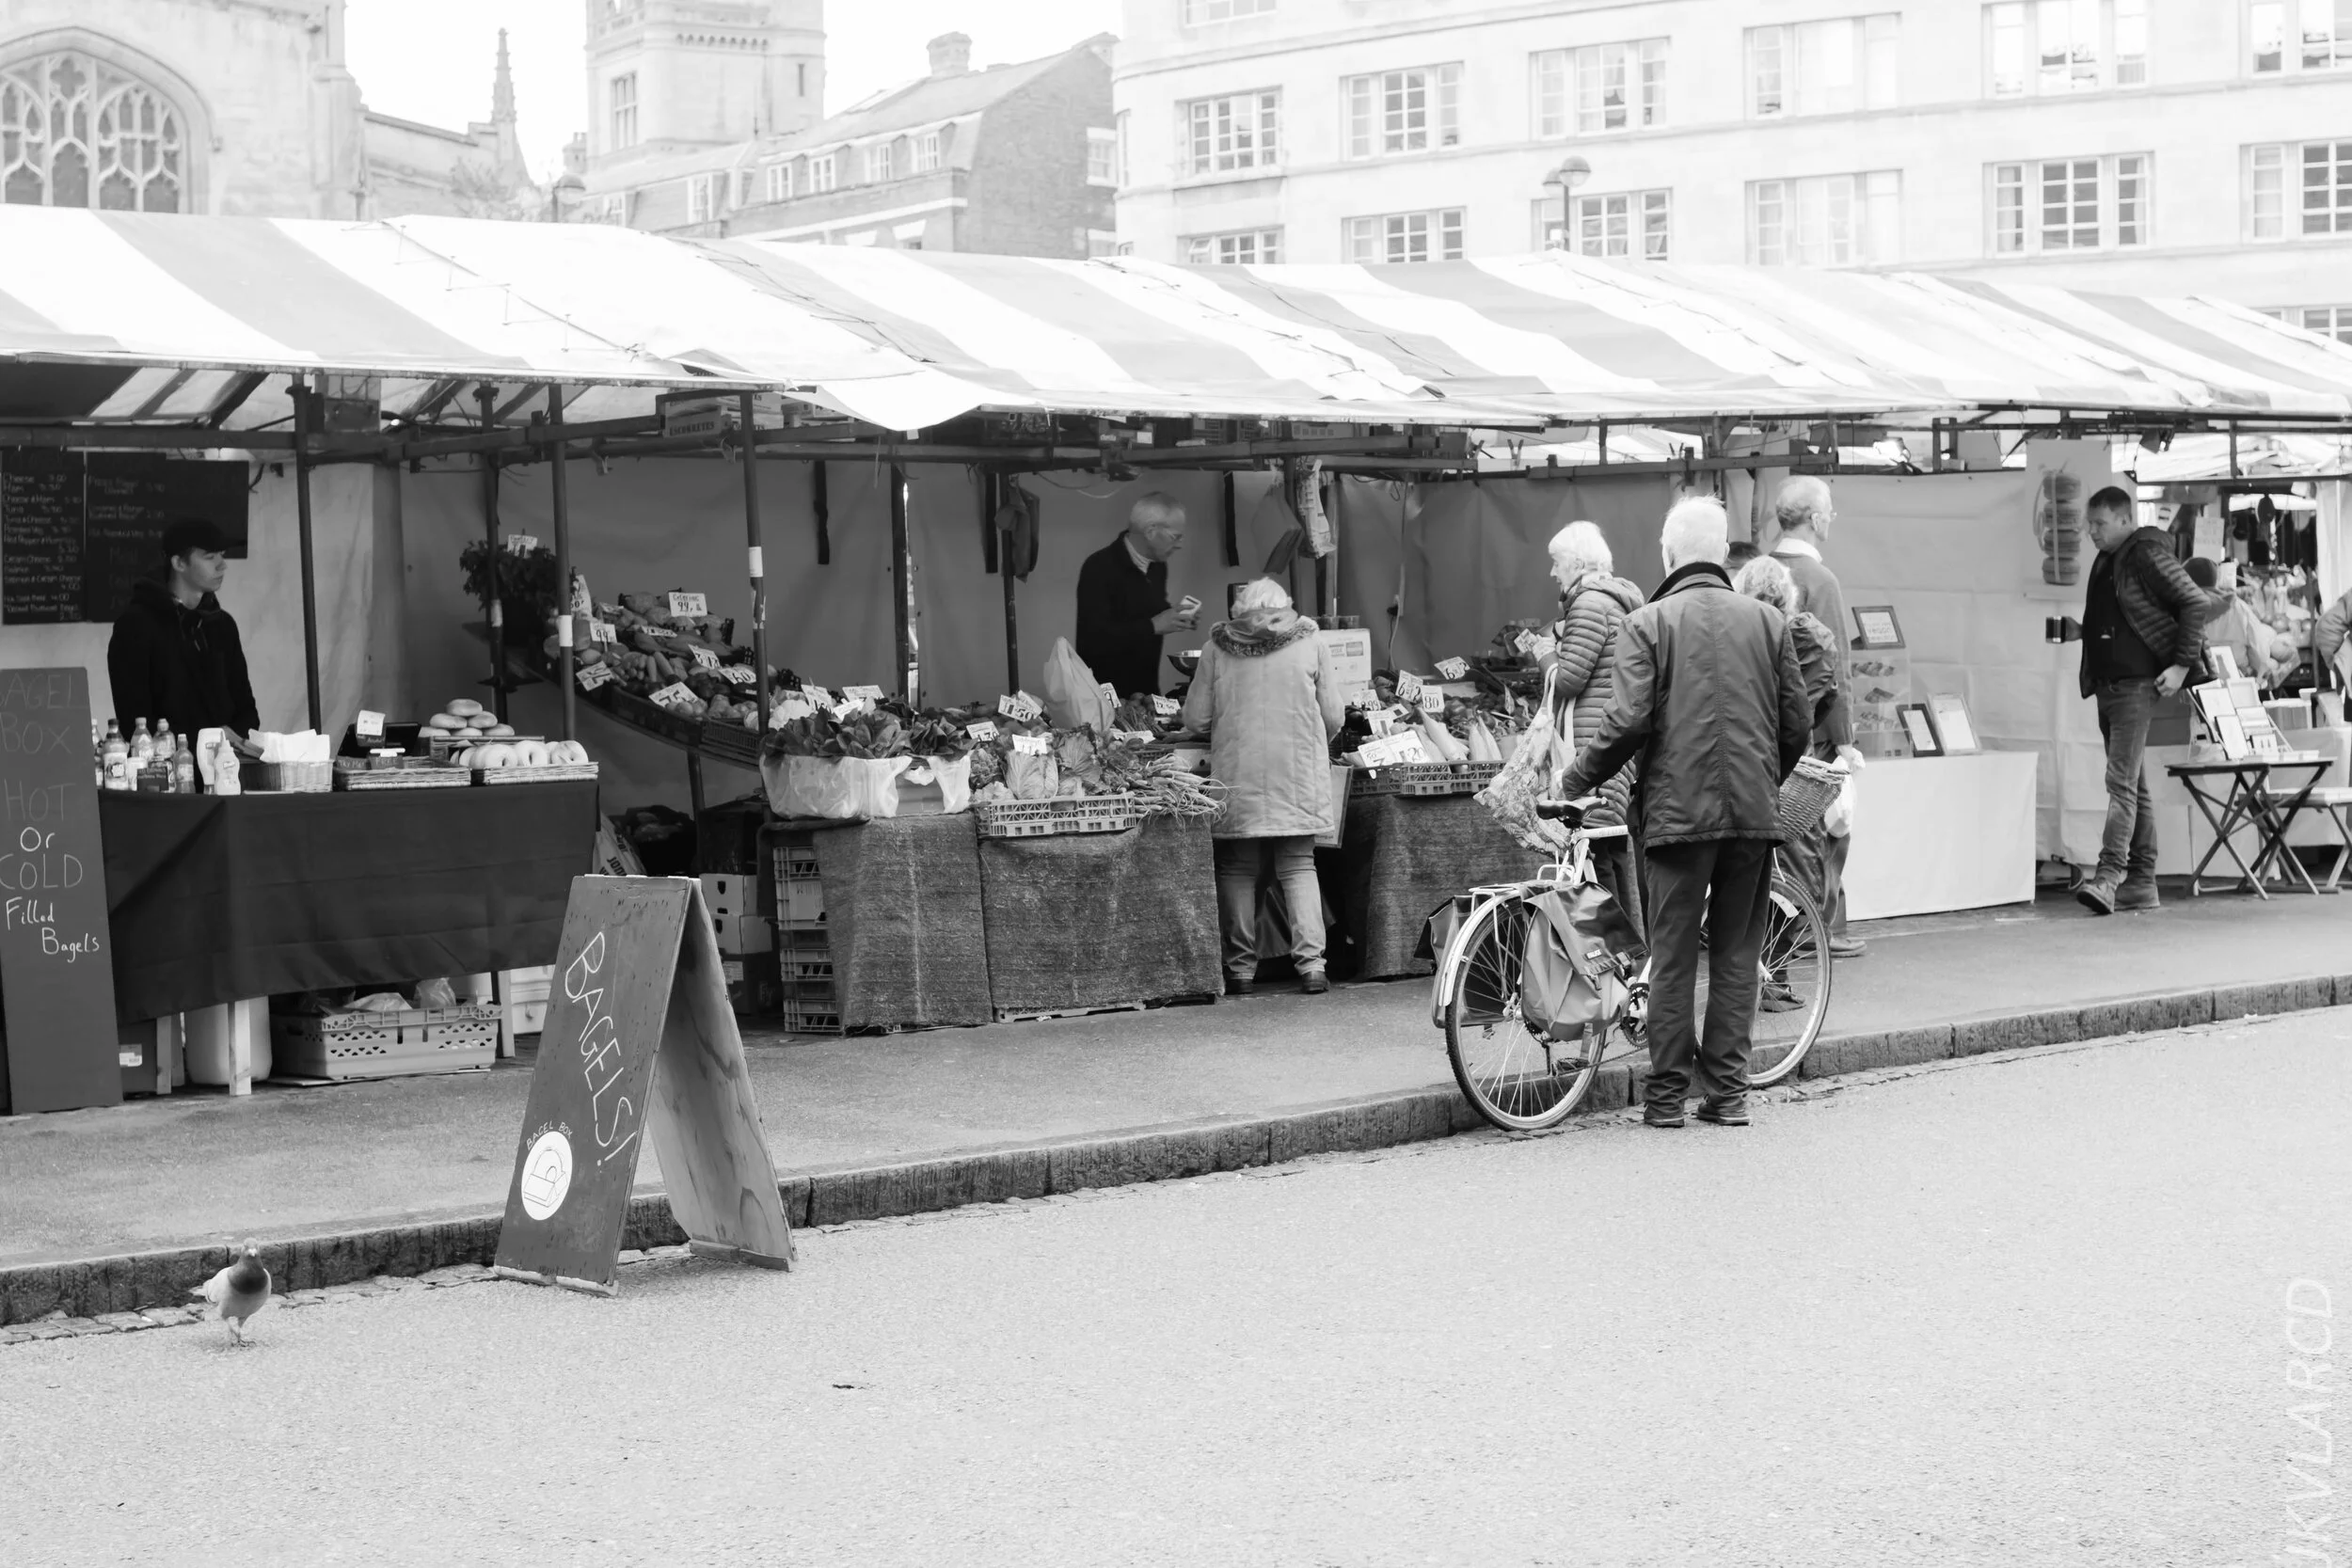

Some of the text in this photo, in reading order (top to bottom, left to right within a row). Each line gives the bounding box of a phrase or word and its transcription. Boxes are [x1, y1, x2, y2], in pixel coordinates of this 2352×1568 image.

[4, 778, 76, 822] HOT
[20, 826, 56, 852] Or
[0, 853, 83, 890] COLD
[6, 896, 55, 930] Filled
[41, 927, 100, 963] Bagels
[559, 1121, 573, 1140] BOX
